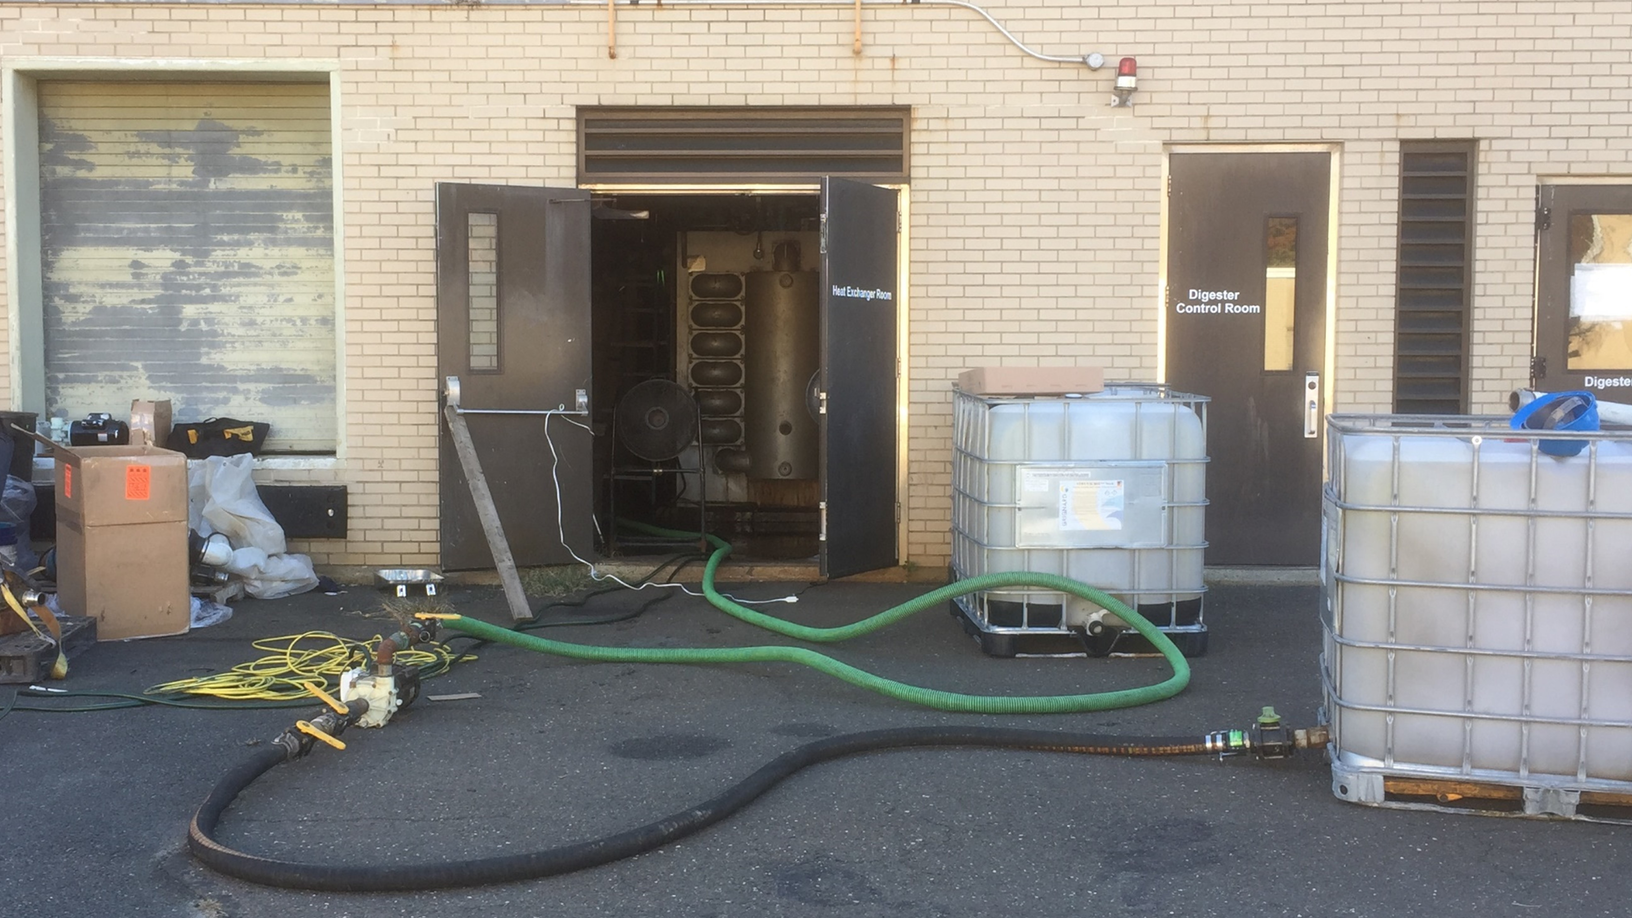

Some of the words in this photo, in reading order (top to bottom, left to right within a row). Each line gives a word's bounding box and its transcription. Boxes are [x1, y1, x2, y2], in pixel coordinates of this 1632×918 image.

[832, 284, 846, 297] Heat
[846, 286, 876, 301] Exchanger
[876, 288, 892, 300] Room
[1188, 289, 1240, 302] Digester
[1176, 302, 1221, 314] Control
[1224, 303, 1260, 314] Room
[1584, 376, 1632, 389] Digeste
